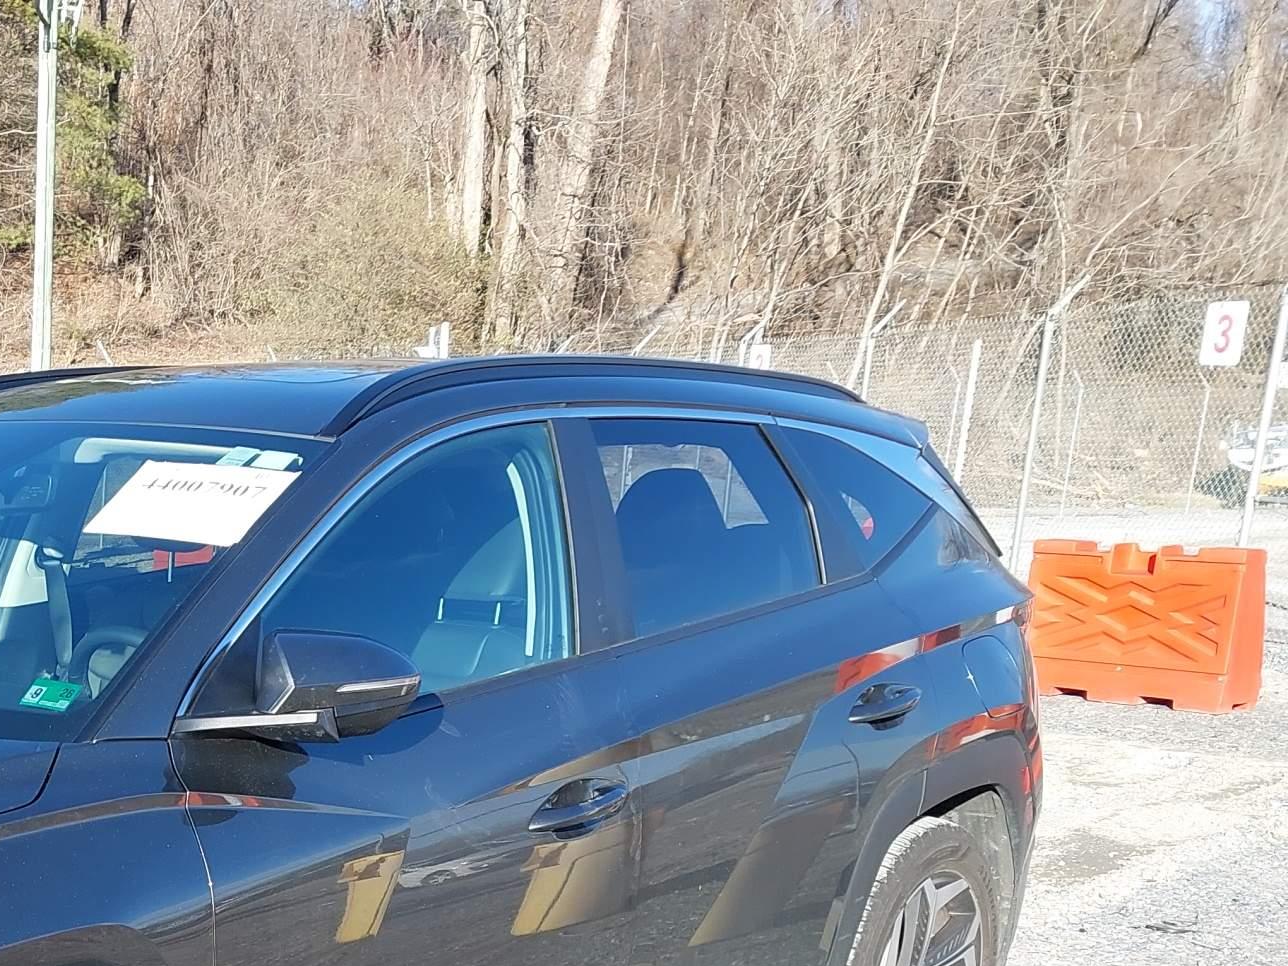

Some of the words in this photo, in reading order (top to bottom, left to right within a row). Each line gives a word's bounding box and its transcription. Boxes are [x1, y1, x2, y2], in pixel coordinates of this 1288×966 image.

[1214, 314, 1234, 353] 3
[142, 477, 268, 499] 44007907
[31, 687, 44, 699] 9
[58, 687, 76, 699] 26
